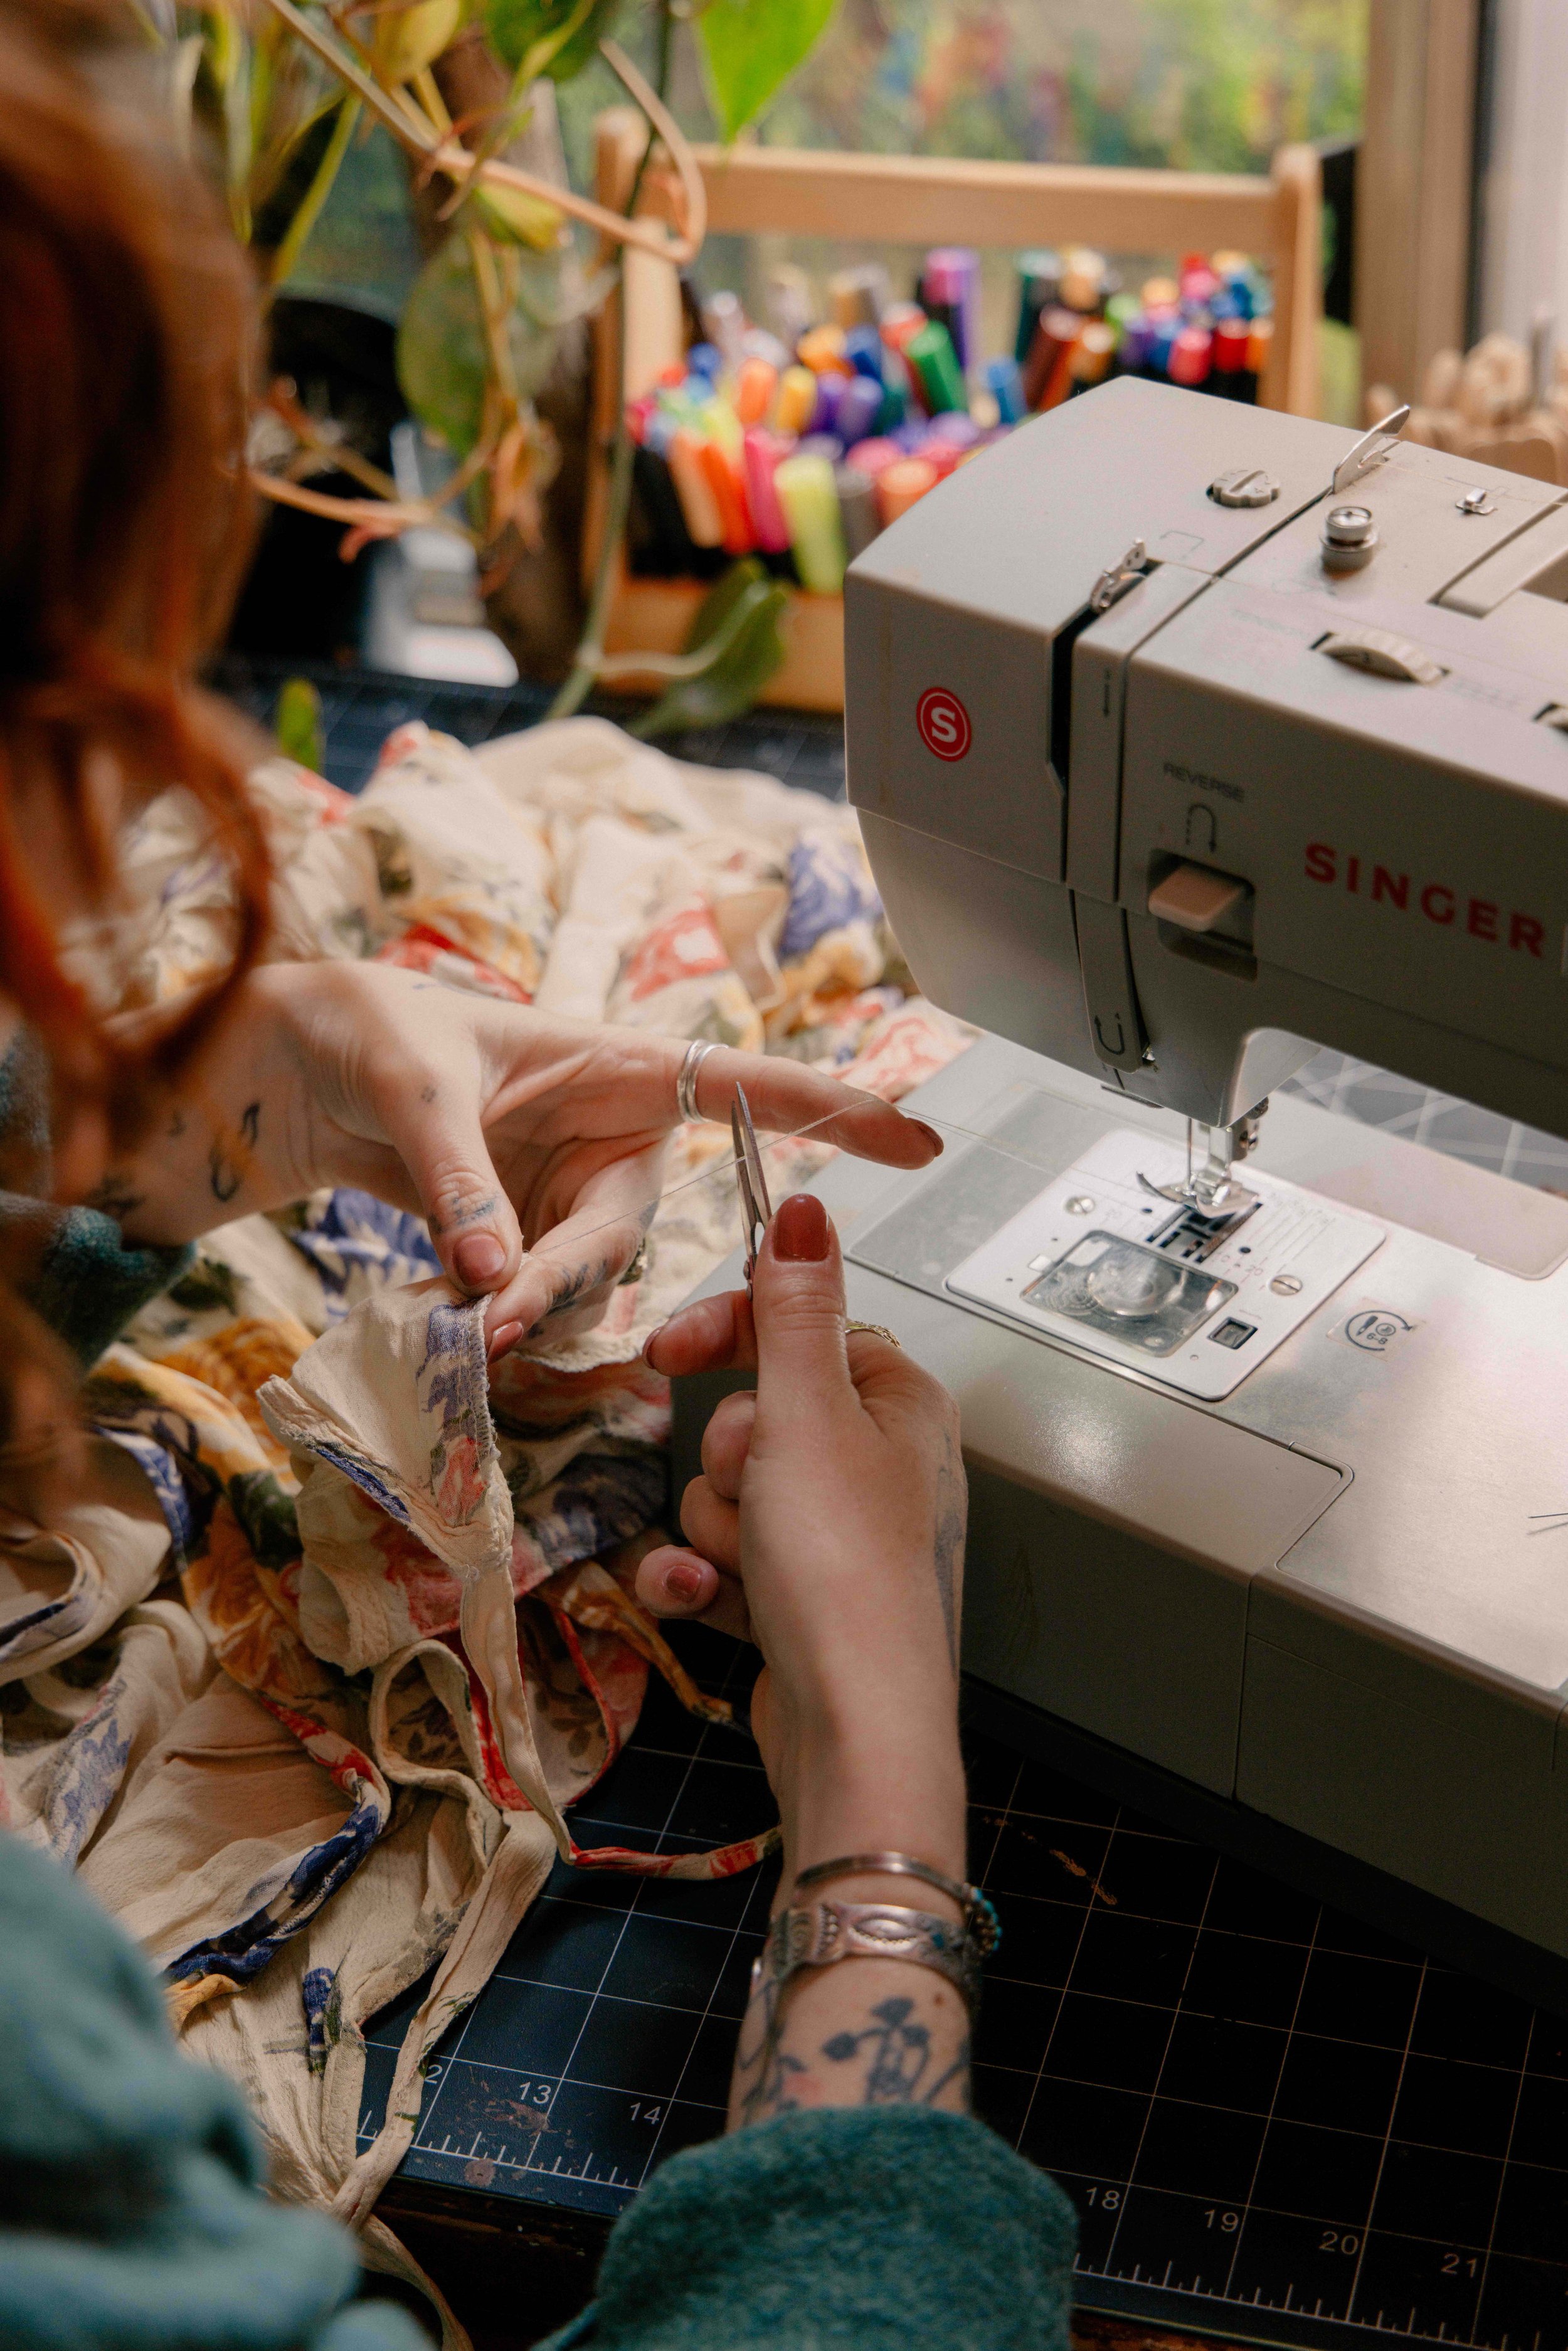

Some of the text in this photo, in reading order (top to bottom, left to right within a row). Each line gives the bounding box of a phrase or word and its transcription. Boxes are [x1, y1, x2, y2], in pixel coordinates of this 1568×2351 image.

[931, 707, 957, 743] S
[1163, 762, 1245, 802] REVERSE
[1304, 842, 1546, 958] SINGER
[1367, 1333, 1388, 1345] 6-8
[425, 2064, 443, 2084] 2
[519, 2081, 552, 2104] 13
[630, 2102, 661, 2125] 14
[1086, 2187, 1120, 2209] 18
[1204, 2209, 1239, 2232] 19
[1318, 2231, 1359, 2255] 20
[1441, 2253, 1476, 2278] 21
